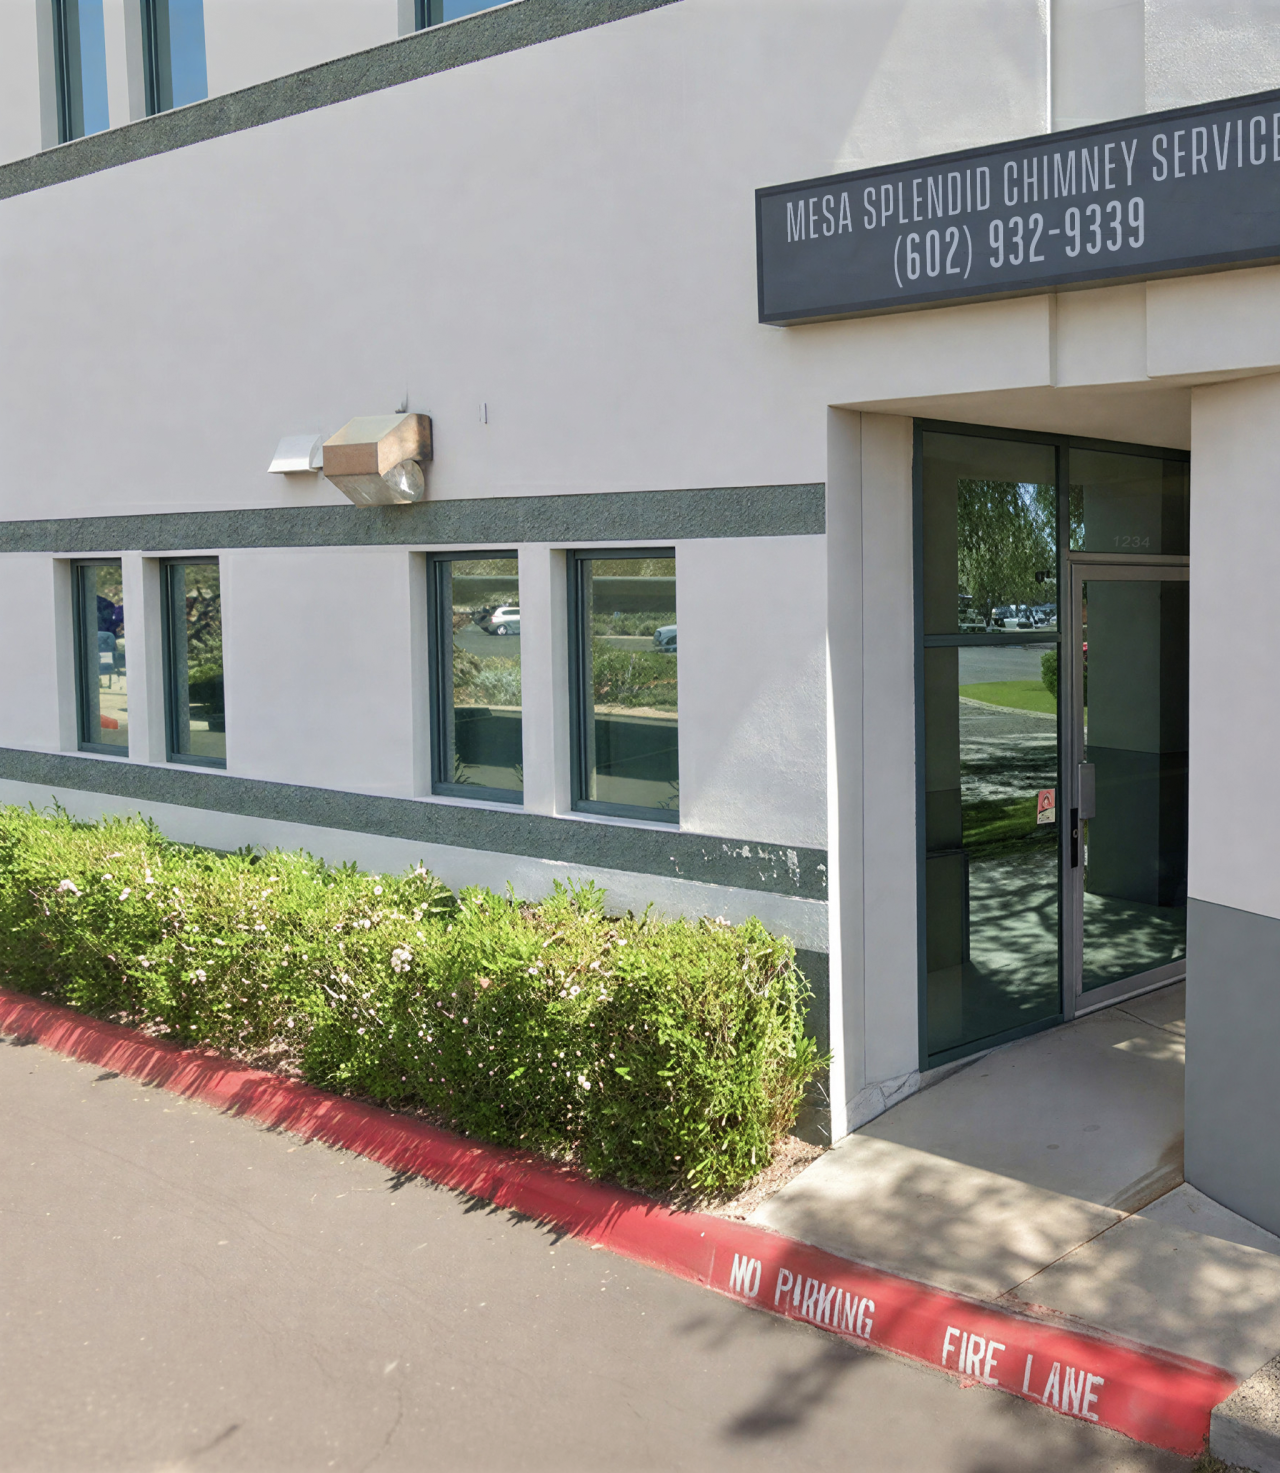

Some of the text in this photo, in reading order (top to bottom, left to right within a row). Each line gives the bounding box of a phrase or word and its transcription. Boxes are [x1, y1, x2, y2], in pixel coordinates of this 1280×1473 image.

[786, 199, 853, 243] MESA
[863, 166, 991, 230] SPLENDID
[1003, 138, 1138, 207] CHIMNEY
[893, 196, 1145, 288] (602) 932-9339
[1113, 535, 1151, 548] 1234
[729, 1253, 1105, 1421] NO PARKING FIRE LANE
